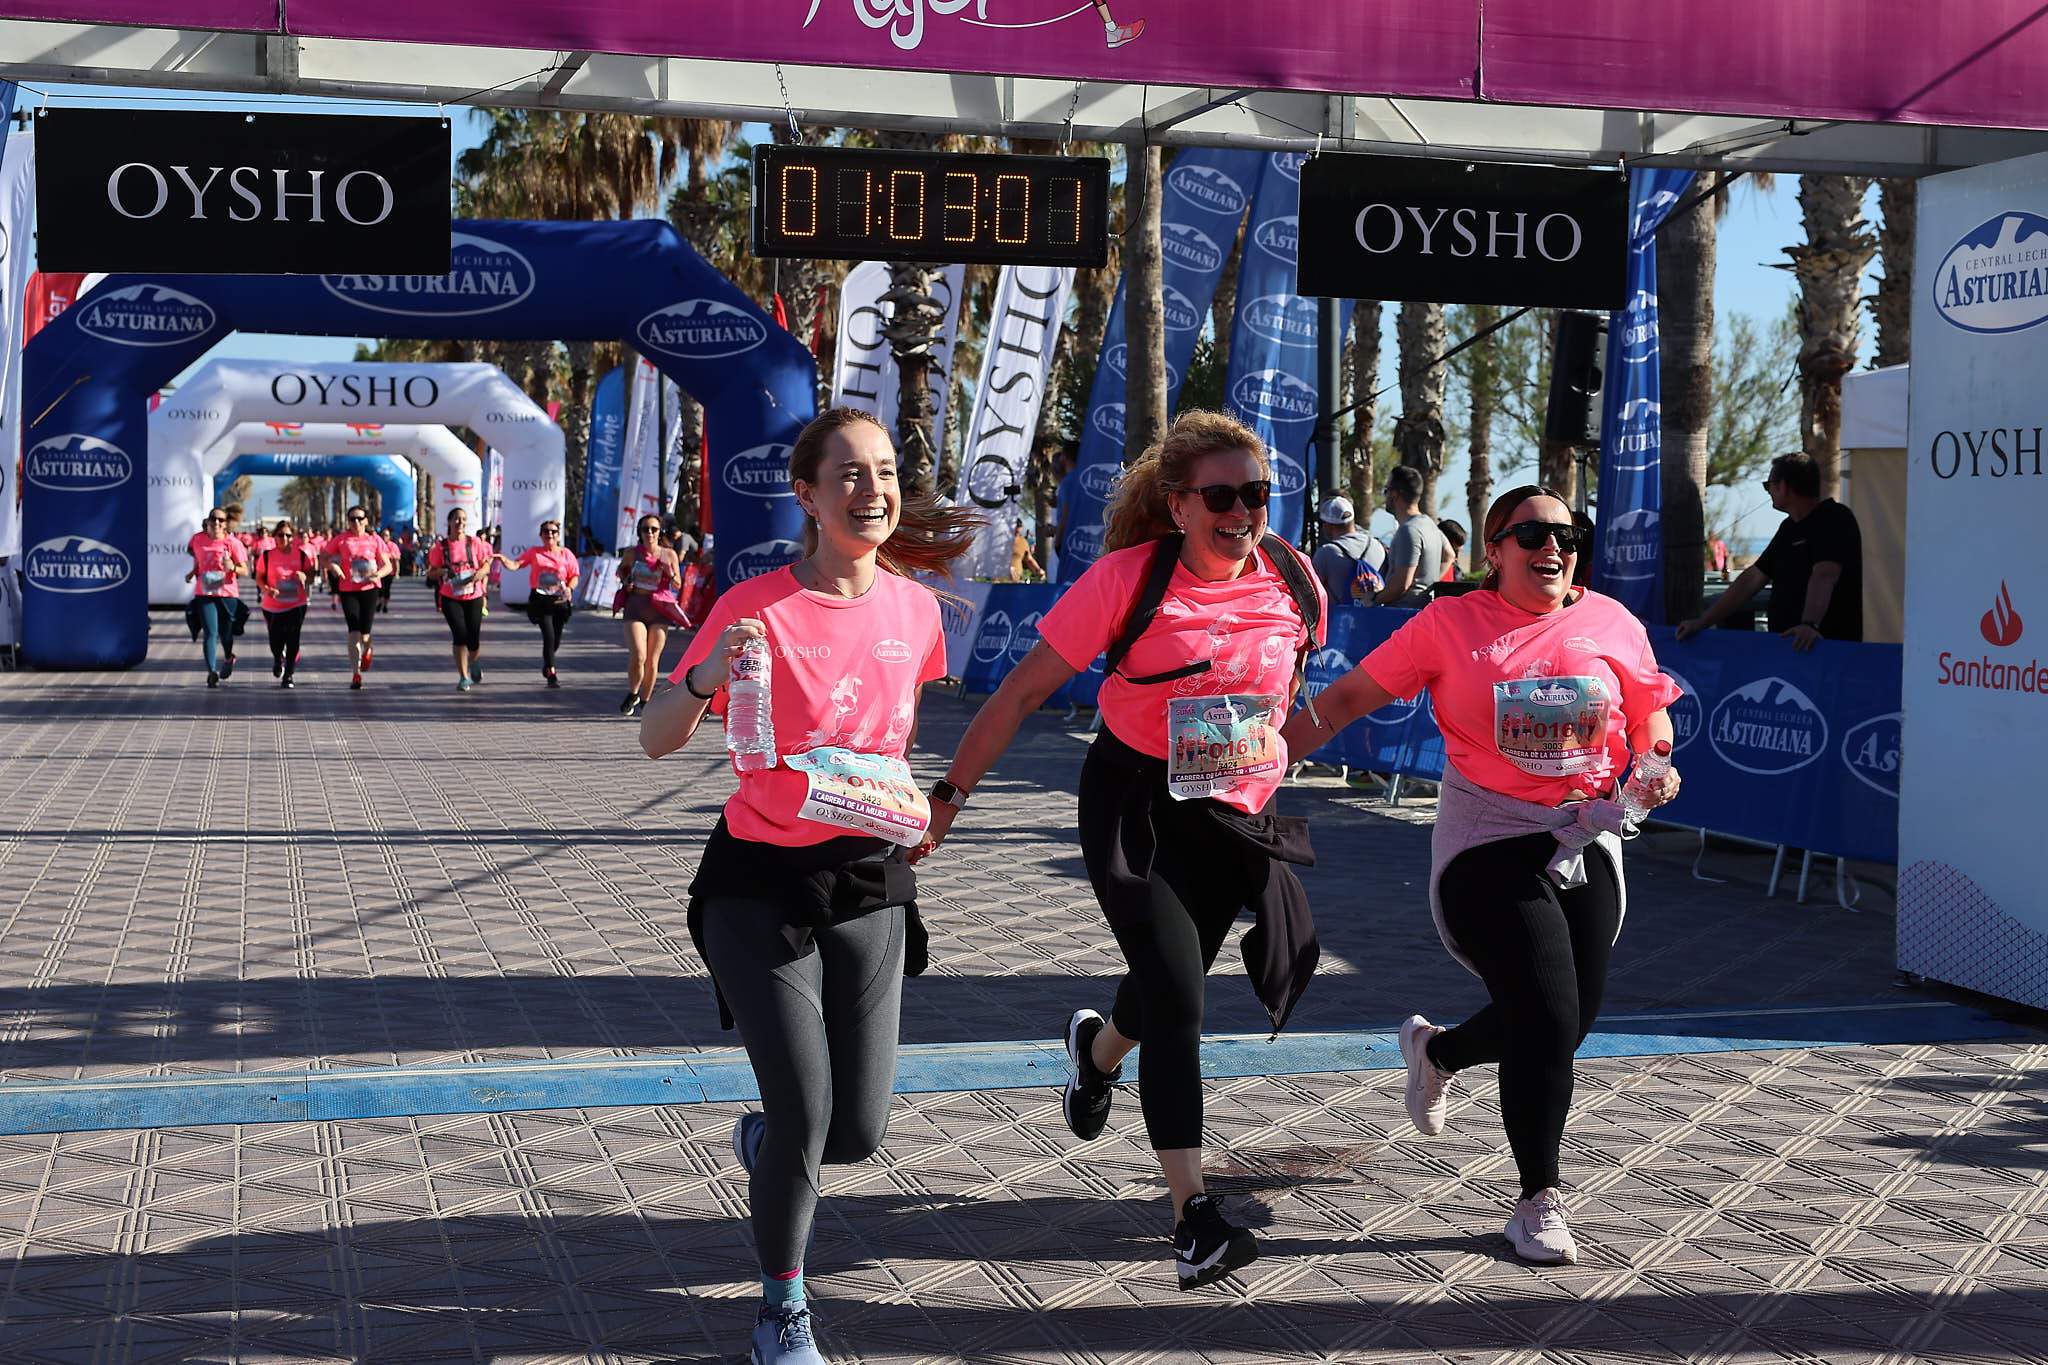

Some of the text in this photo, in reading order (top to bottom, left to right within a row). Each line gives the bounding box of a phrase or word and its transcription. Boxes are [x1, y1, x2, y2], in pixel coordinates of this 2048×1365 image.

[107, 162, 394, 226] OYSHO
[1355, 203, 1581, 262] OYSHO
[453, 255, 512, 266] ECHERA
[1163, 237, 1216, 268] STURIANA
[1965, 248, 2048, 271] CENTRAL LECH
[85, 309, 204, 332] ASTURIANA
[649, 323, 759, 344] ASTURIANA
[271, 373, 439, 408] OYSHO
[1240, 382, 1314, 415] ASTURIANA
[168, 409, 219, 420] OYSHO
[486, 412, 537, 423] OYSHO
[1931, 427, 2048, 479] OYSH
[30, 456, 125, 478] ASTURIANA
[730, 464, 792, 485] ASTURI
[512, 479, 558, 491] OYSHO
[29, 558, 123, 579] ASTURIANA
[775, 646, 831, 658] OYSHO
[1533, 693, 1575, 702] ASTURIANA
[1715, 707, 1812, 756] ASTURIANA
[1209, 738, 1248, 759] 016
[1502, 748, 1529, 757] CARRERA
[1176, 774, 1205, 782] CARRERA
[816, 792, 845, 807] CARRERA
[846, 800, 856, 809] DE
[856, 803, 865, 812] LA
[865, 806, 888, 818] MUJER
[892, 814, 921, 828] VALENCIA
[861, 793, 881, 806] 3423
[816, 807, 854, 822] OYSHO
[874, 824, 909, 840] Santander
